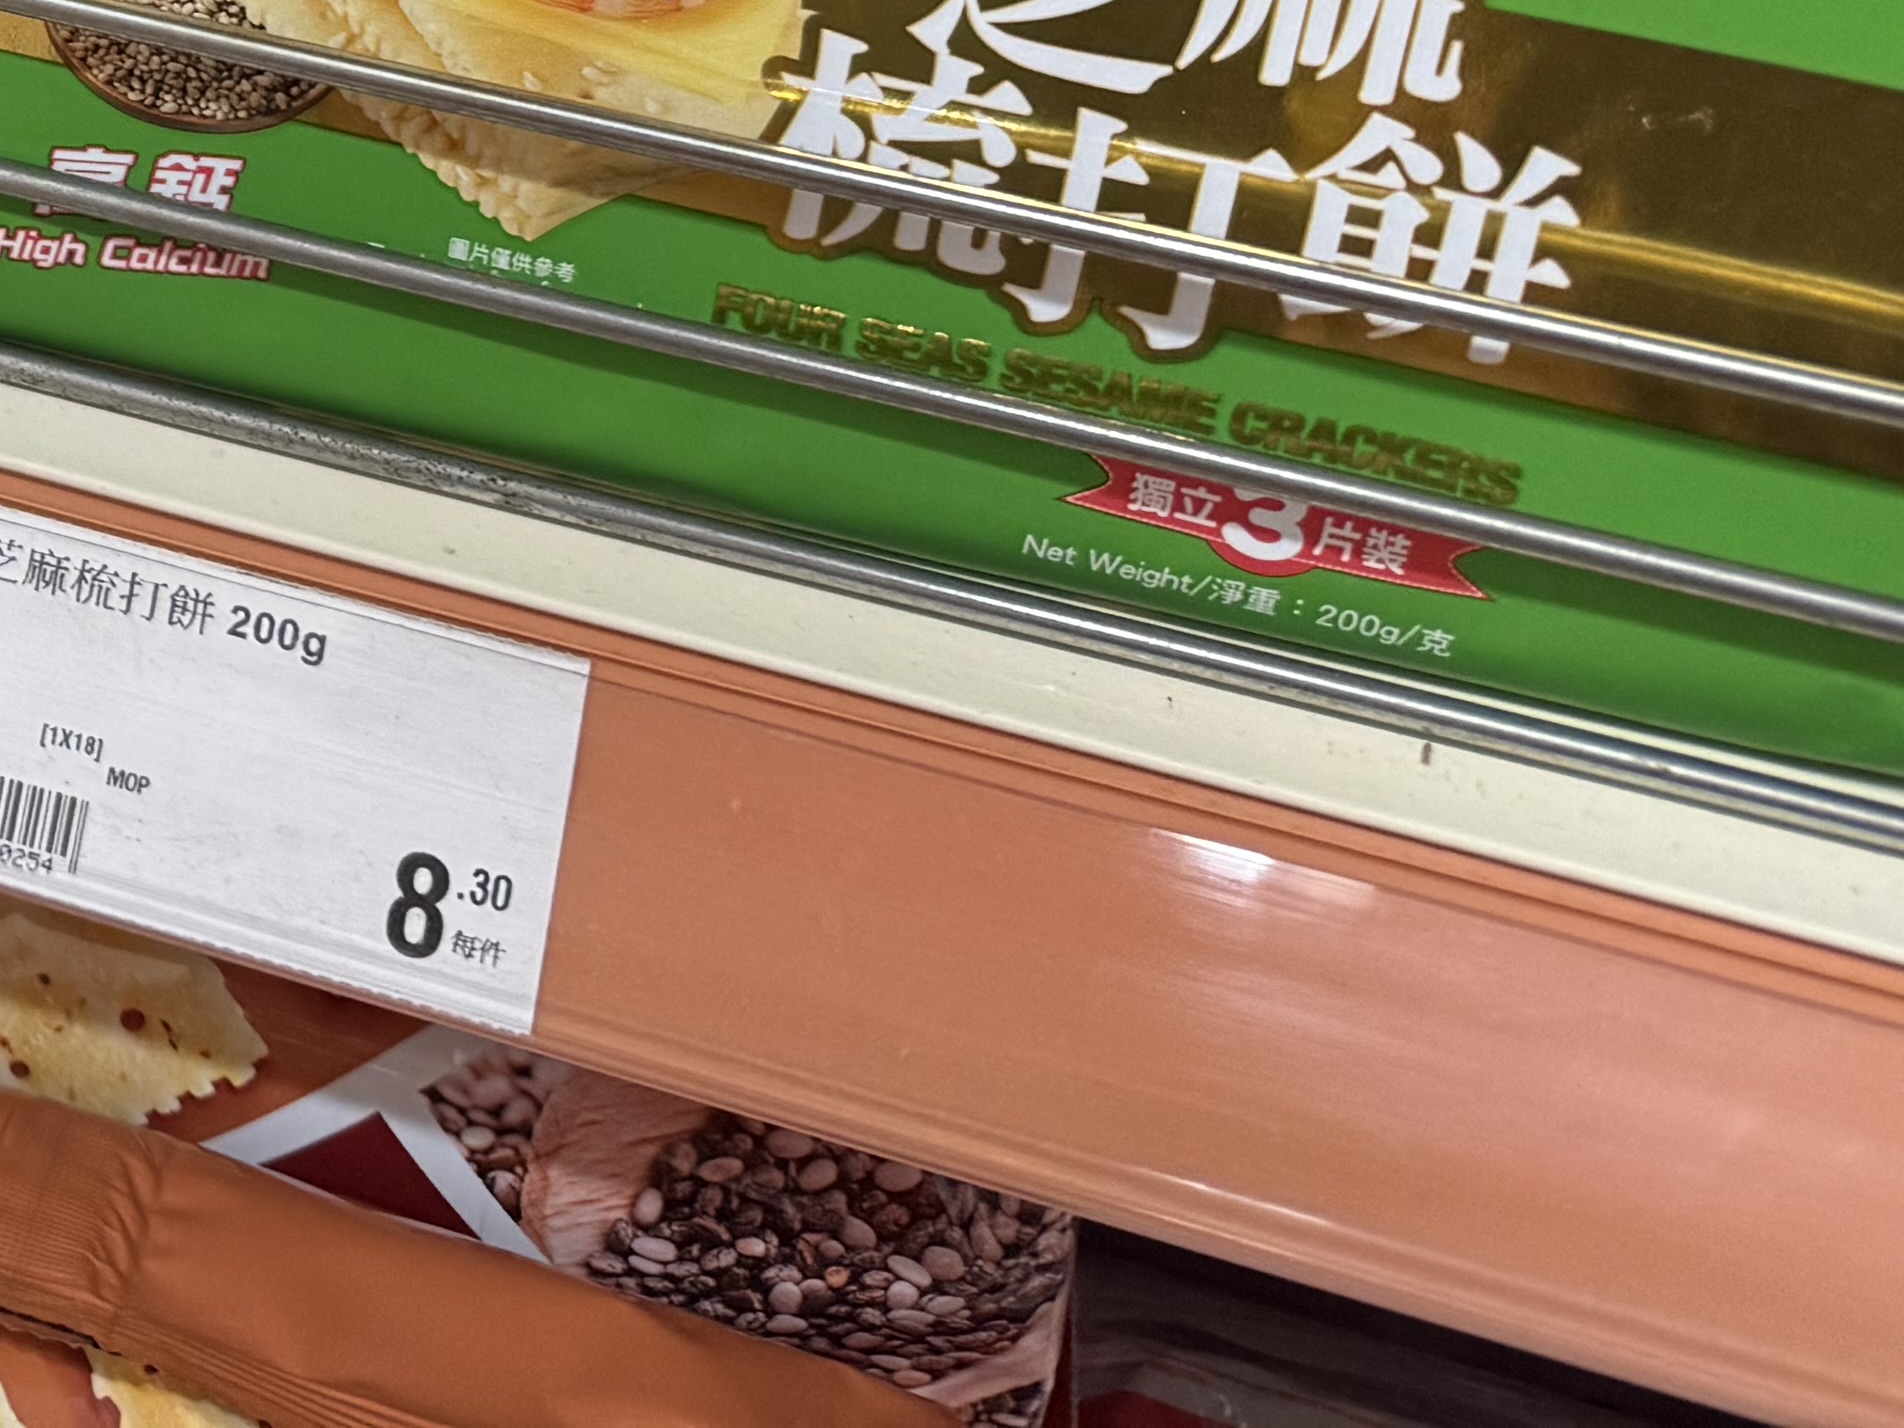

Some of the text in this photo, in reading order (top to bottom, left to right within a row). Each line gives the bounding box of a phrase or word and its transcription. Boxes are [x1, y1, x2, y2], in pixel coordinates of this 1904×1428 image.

[776, 27, 1583, 368] 梳打餅
[99, 236, 270, 280] Calcium
[711, 282, 1523, 507] FOUR SEAS SESAME CRACKERS
[1021, 531, 1079, 572] Net
[226, 604, 330, 669] 200g
[38, 723, 105, 764] [1X18]
[106, 764, 153, 798] MOP
[384, 849, 515, 961] 8 .30
[450, 929, 508, 969] 每件
